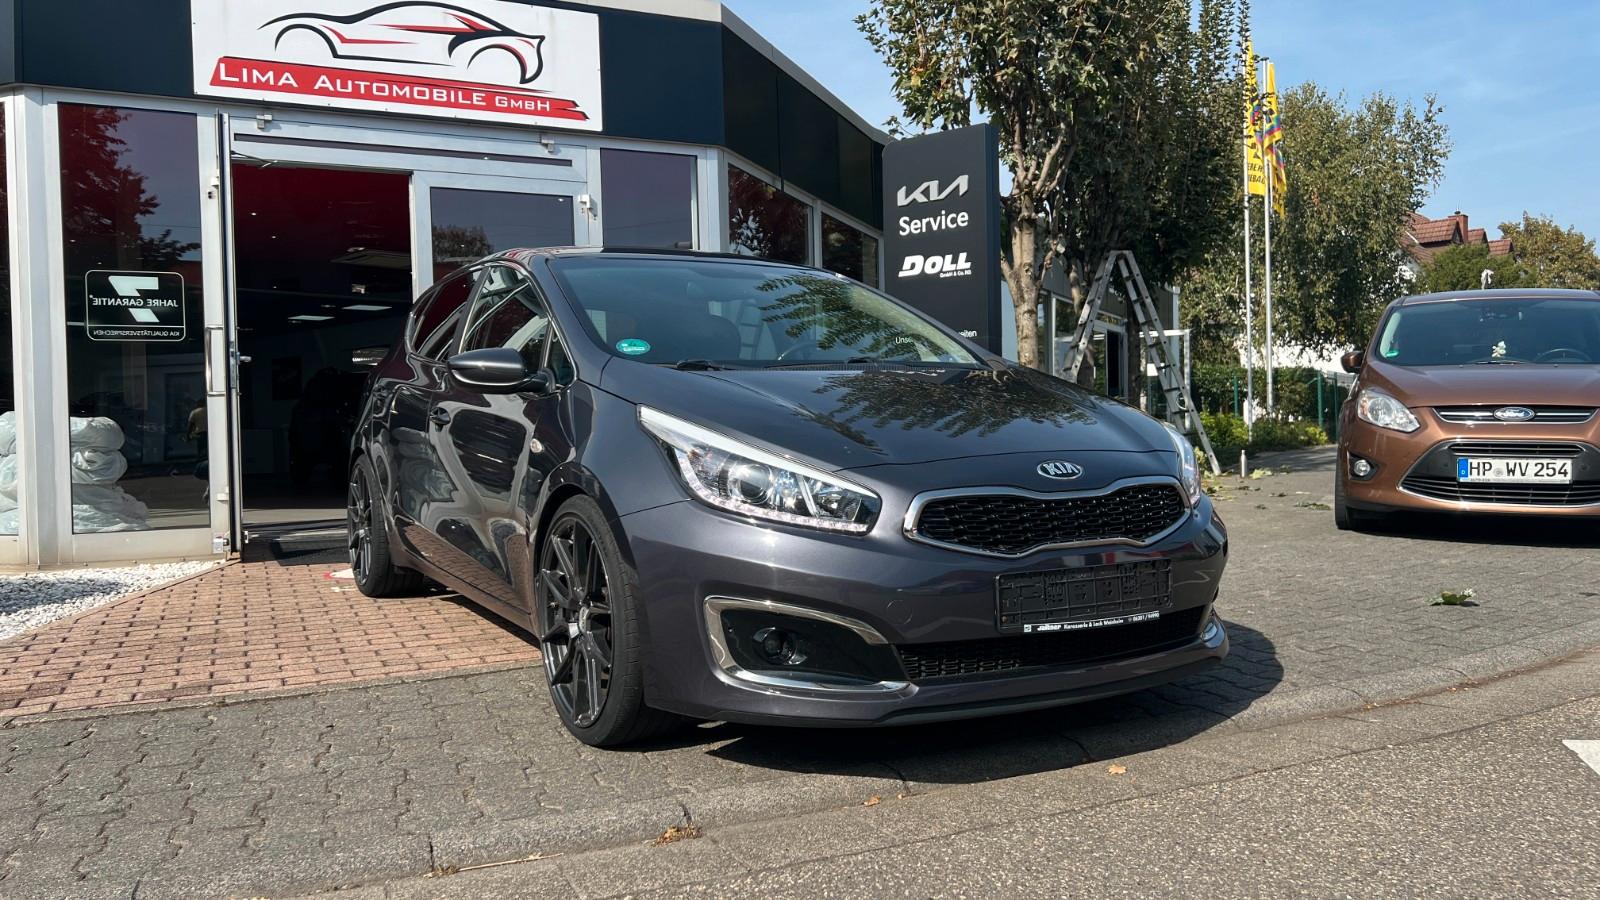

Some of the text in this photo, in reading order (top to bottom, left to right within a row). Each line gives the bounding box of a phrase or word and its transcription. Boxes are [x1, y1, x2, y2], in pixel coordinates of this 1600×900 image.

[899, 210, 969, 236] Service
[898, 252, 972, 278] DOLL
[1043, 462, 1079, 475] KIA
[1469, 461, 1569, 477] HP WV 254
